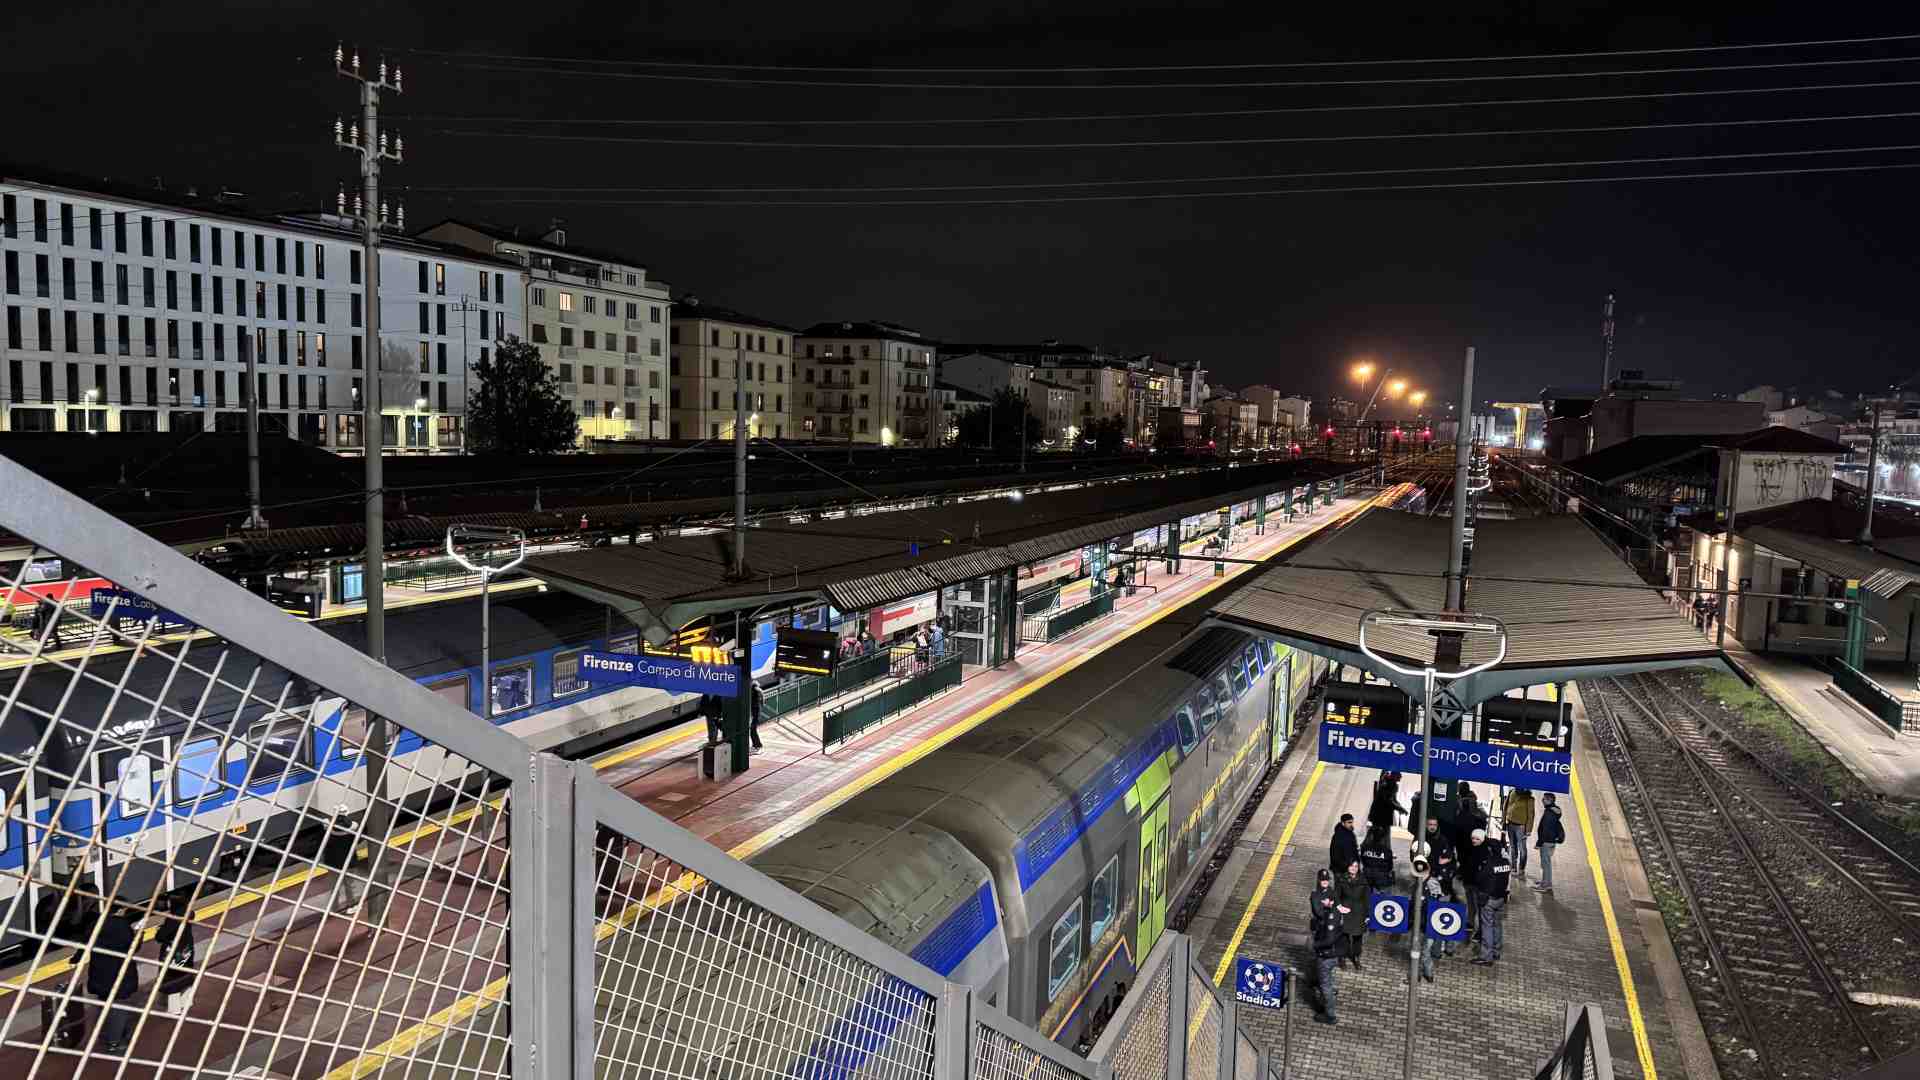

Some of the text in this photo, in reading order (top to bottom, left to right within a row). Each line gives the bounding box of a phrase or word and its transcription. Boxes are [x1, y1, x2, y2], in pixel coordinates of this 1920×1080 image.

[94, 592, 131, 607] Fireze
[583, 654, 736, 683] Firenze Campo di Marte
[1327, 702, 1336, 712] 8
[1327, 729, 1571, 775] Firenze Campo di Marte
[1382, 905, 1396, 923] 8
[1439, 912, 1454, 930] 9
[1236, 991, 1271, 1007] Stadio
